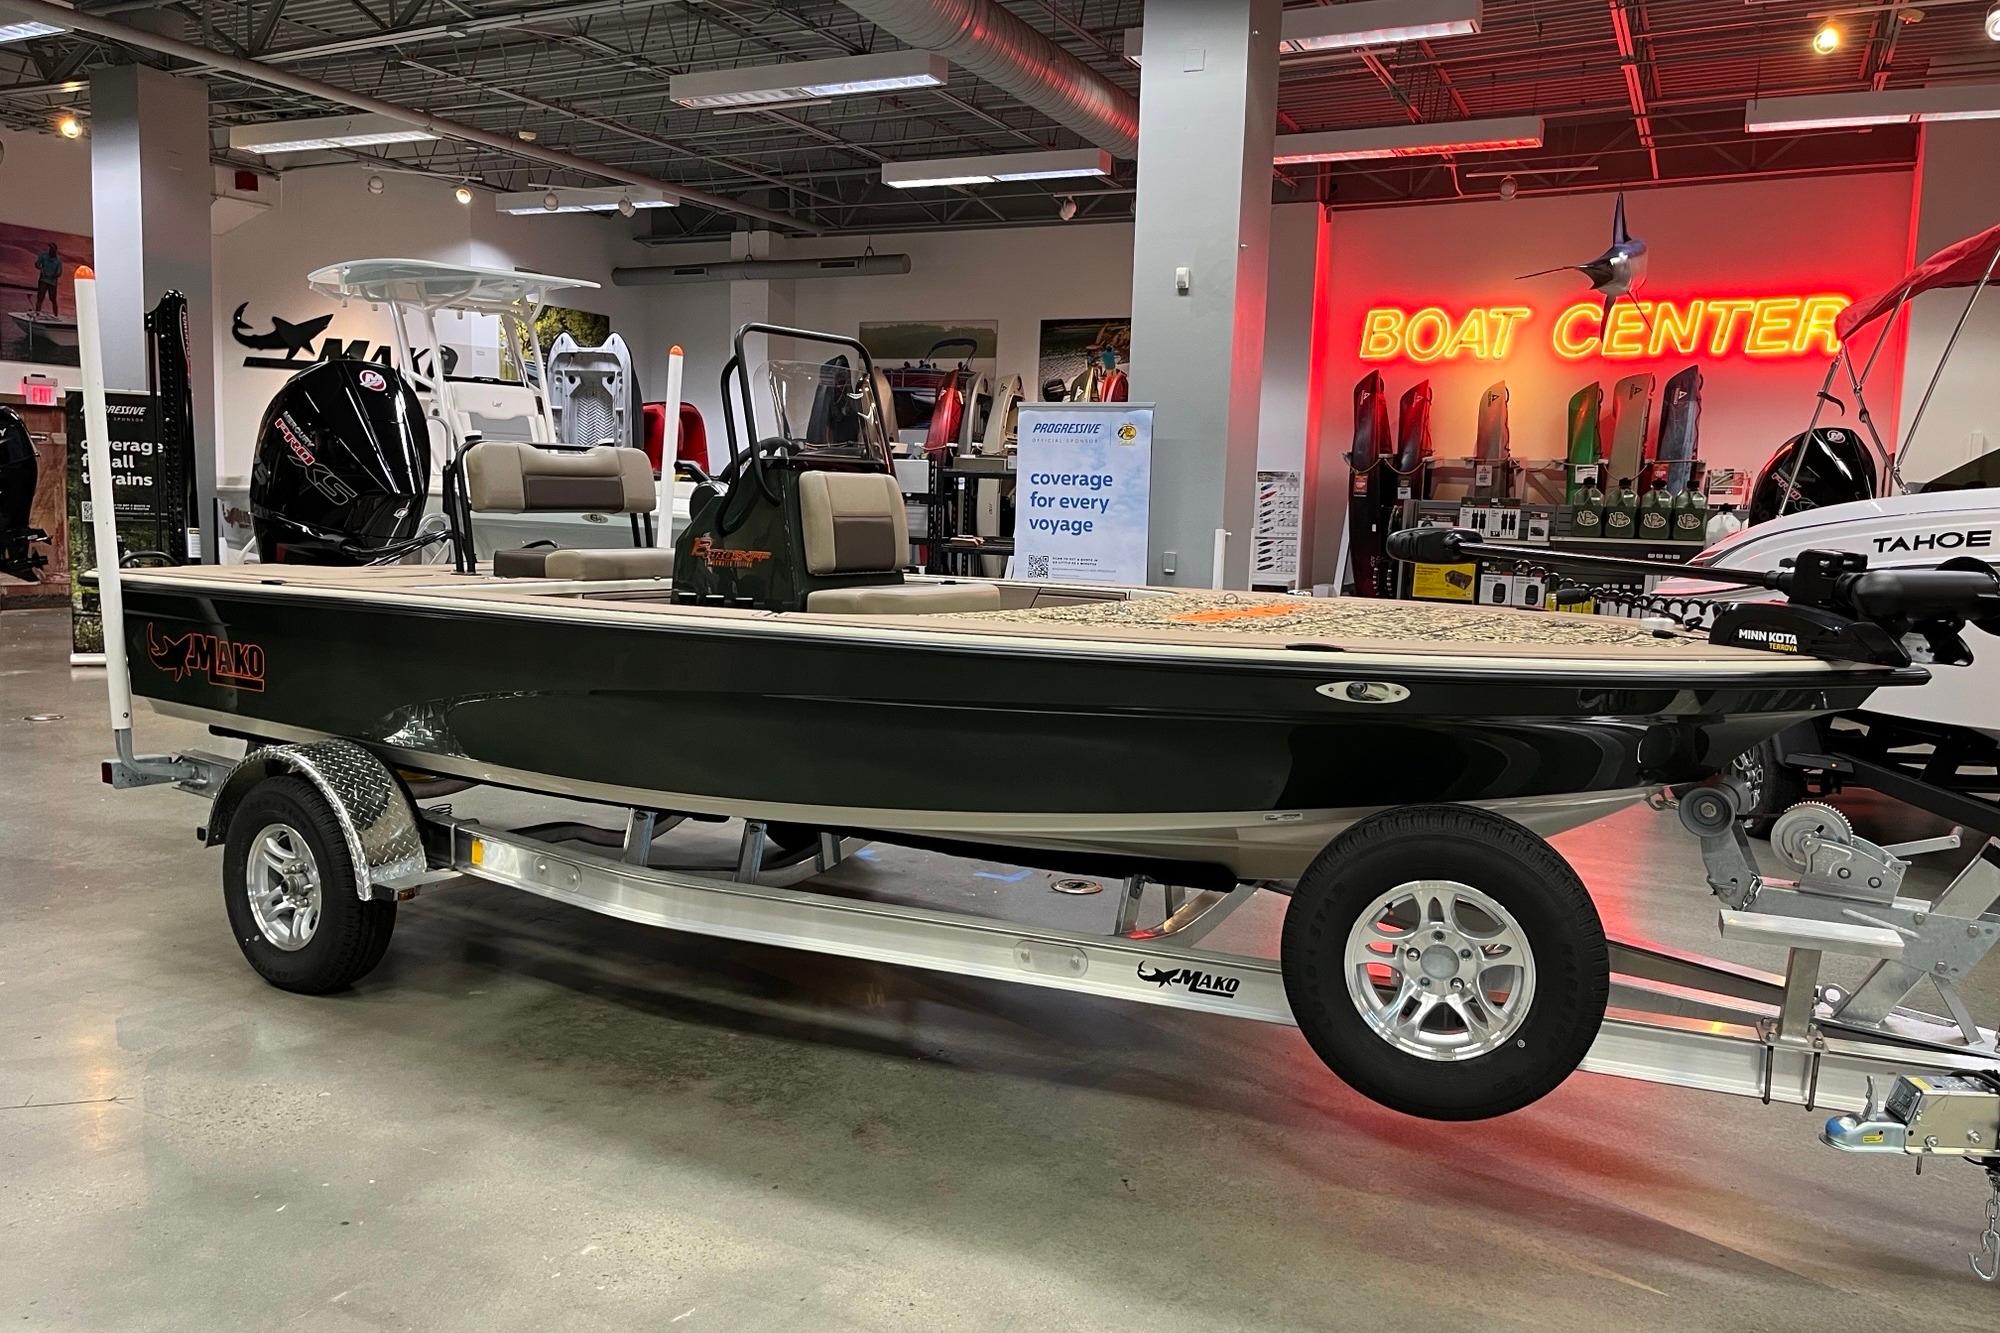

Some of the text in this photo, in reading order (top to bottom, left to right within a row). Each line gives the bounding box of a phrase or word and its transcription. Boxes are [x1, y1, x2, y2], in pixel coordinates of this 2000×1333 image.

[1359, 297, 1850, 363] BOAT CENTER
[282, 410, 316, 448] MERCURY
[1032, 423, 1102, 434] PROGRESSIVE
[111, 454, 135, 469] all
[274, 417, 358, 506] PRO XS
[1030, 472, 1113, 490] coverage
[1030, 490, 1110, 514] for every
[1029, 518, 1094, 536] voyage
[1873, 530, 1992, 553] TAHOE
[1738, 628, 1798, 645] MINN KOTA
[1769, 642, 1798, 652] TERROVA
[187, 633, 265, 693] MAKO
[1171, 969, 1241, 999] MAKO
